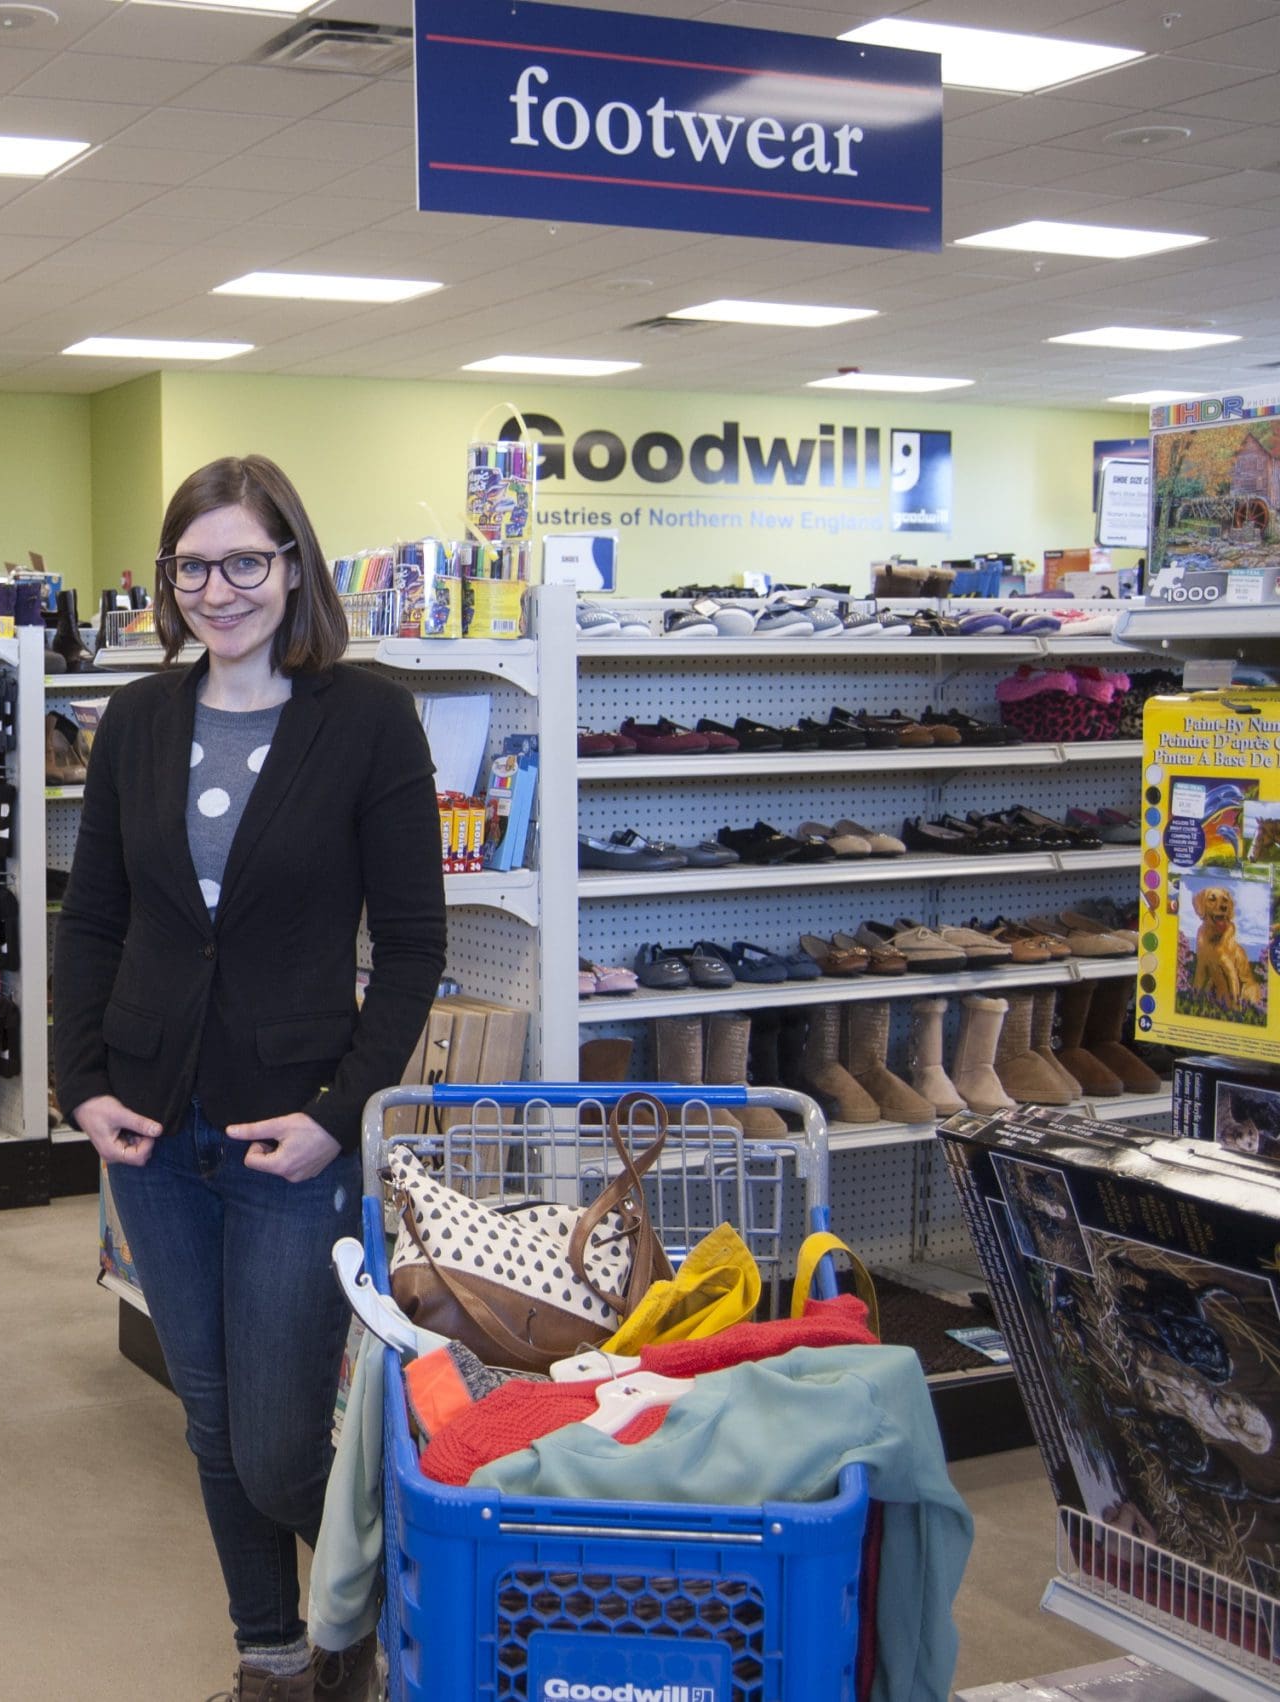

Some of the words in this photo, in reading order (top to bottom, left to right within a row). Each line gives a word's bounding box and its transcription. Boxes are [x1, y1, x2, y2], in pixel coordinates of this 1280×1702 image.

[509, 65, 863, 177] footwear
[1180, 395, 1244, 424] HDR
[498, 413, 881, 488] Goodwill
[536, 507, 612, 526] ustries
[620, 507, 641, 526] of
[649, 508, 743, 528] Northern
[750, 510, 795, 530] New
[801, 511, 884, 535] England
[892, 509, 949, 530] goodwill
[1164, 586, 1219, 602] 1000
[1184, 717, 1244, 733] Paint-By
[1160, 733, 1210, 748] Peindre
[1153, 750, 1195, 765] Pintar
[1198, 752, 1210, 766] A
[1214, 751, 1245, 767] Base
[1250, 752, 1272, 768] De
[457, 821, 465, 859] CRAYONS
[473, 820, 481, 858] CRAYONS
[544, 1678, 689, 1702] Goodwill
